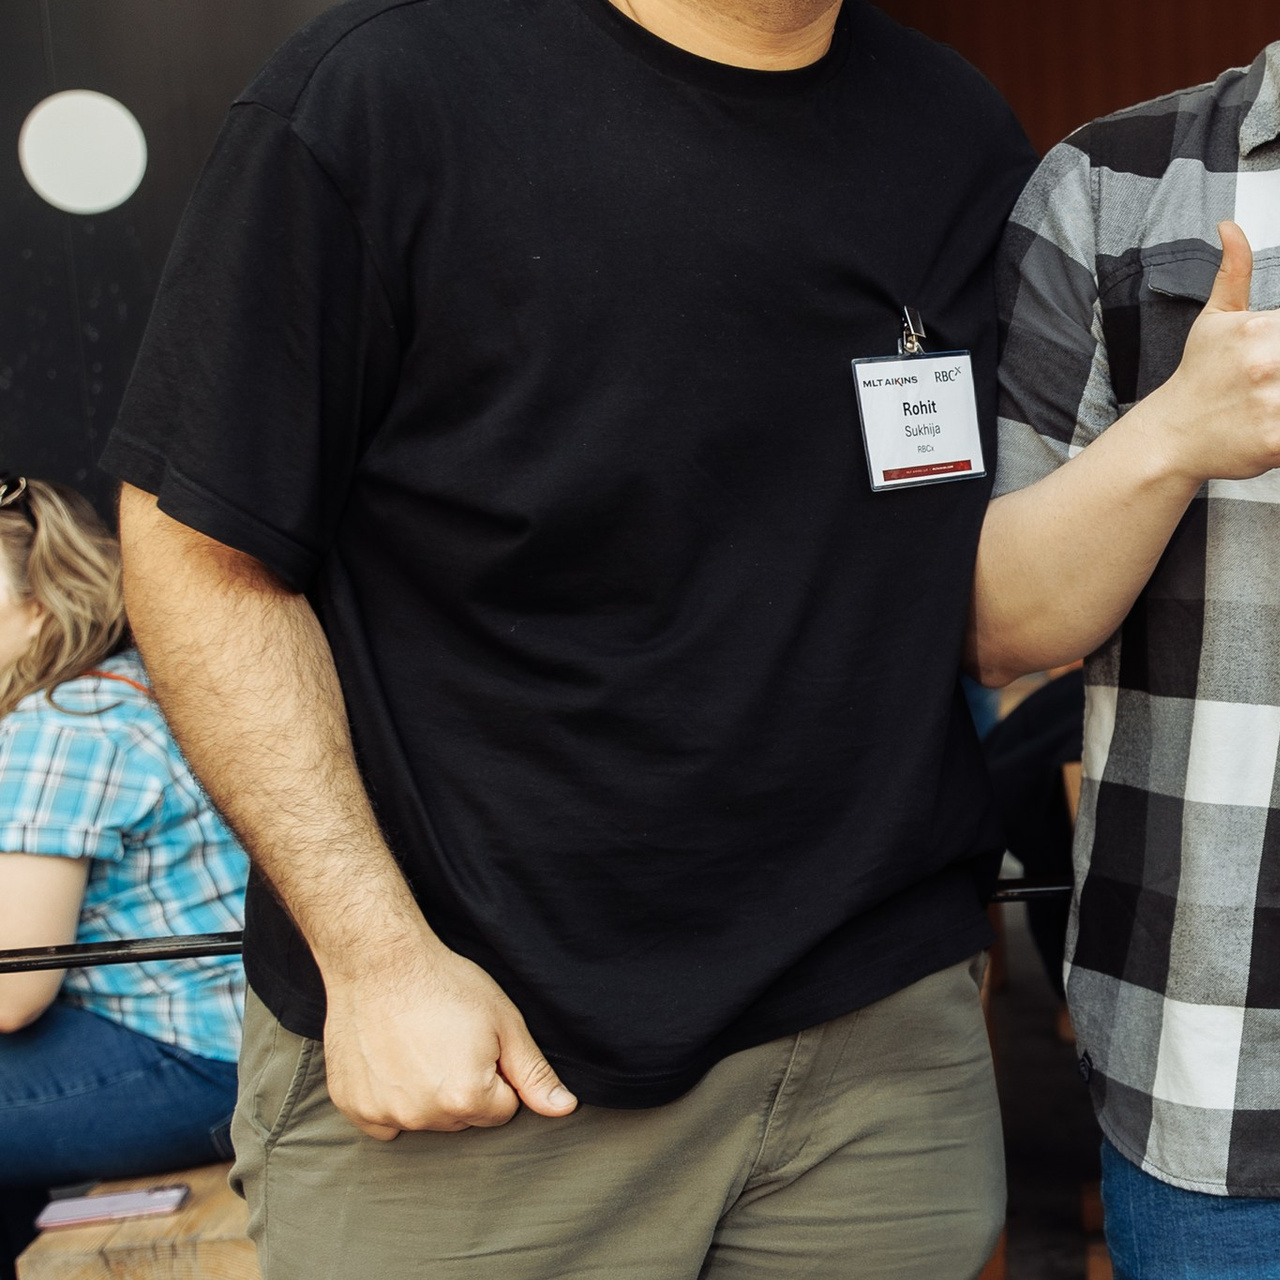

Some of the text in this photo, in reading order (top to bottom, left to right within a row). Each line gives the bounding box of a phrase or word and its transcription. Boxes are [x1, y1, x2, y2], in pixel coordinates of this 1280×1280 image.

[863, 376, 918, 388] MLT AIKINS
[902, 400, 937, 416] Rohit
[905, 423, 941, 438] Sukhija
